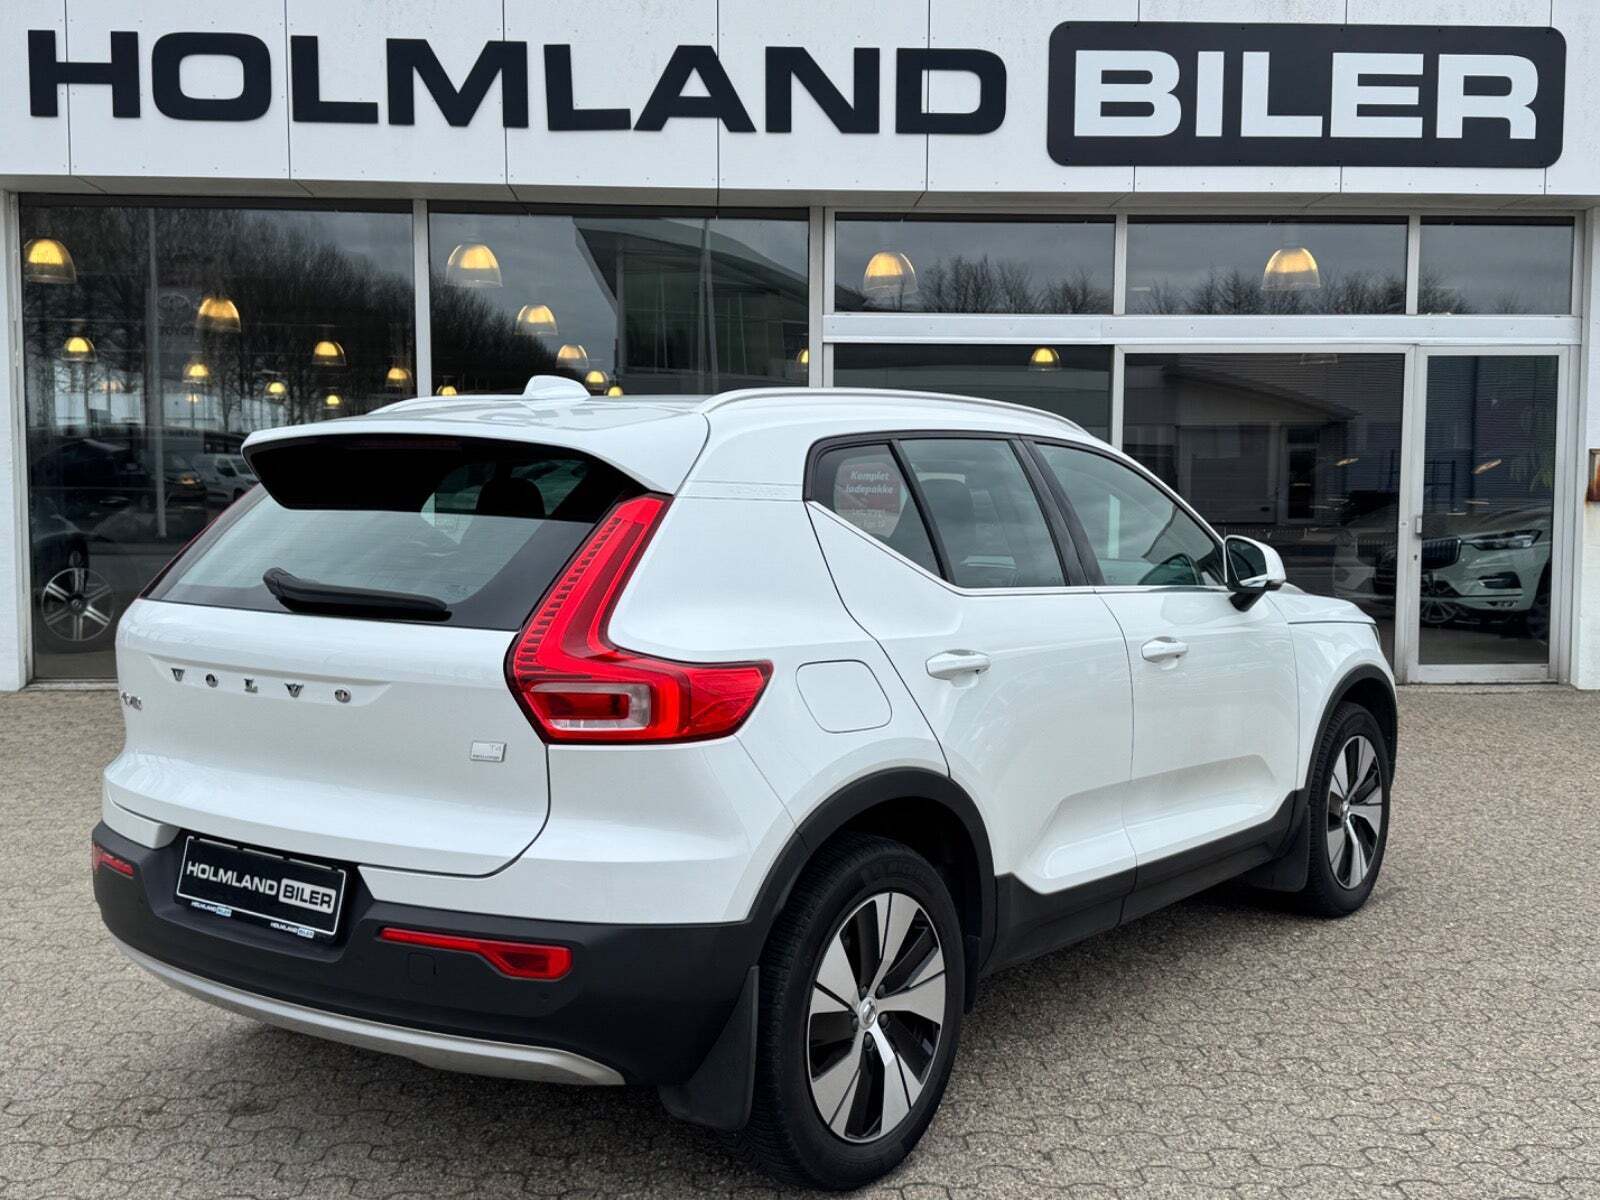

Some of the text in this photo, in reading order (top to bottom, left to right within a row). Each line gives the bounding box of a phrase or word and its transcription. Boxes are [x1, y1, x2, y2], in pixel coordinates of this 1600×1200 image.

[28, 30, 1538, 140] HOLMLAND BILER
[850, 470, 890, 482] Komplet
[171, 667, 352, 704] VOLVO
[186, 861, 332, 909] HOLMLAND BILER
